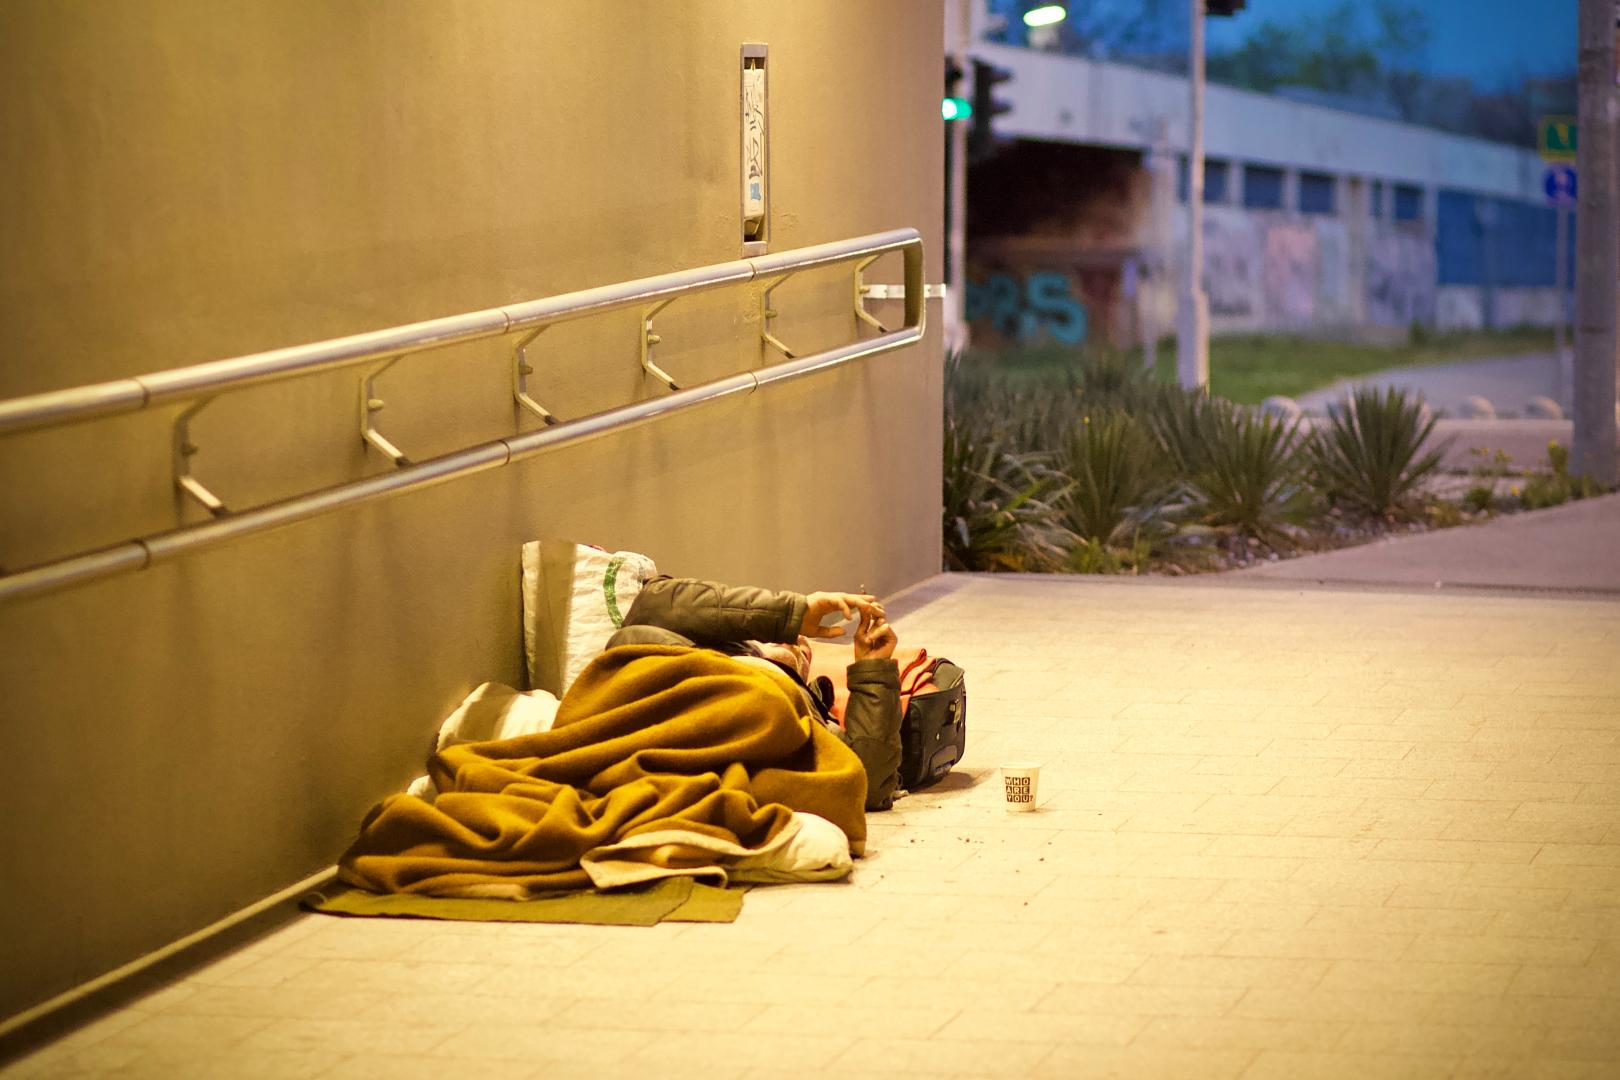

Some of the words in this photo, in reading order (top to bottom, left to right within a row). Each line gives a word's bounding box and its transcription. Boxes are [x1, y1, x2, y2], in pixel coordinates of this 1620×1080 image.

[1005, 776, 1031, 786] WHO
[1005, 785, 1030, 795] ARE
[1006, 794, 1034, 803] YOU?
